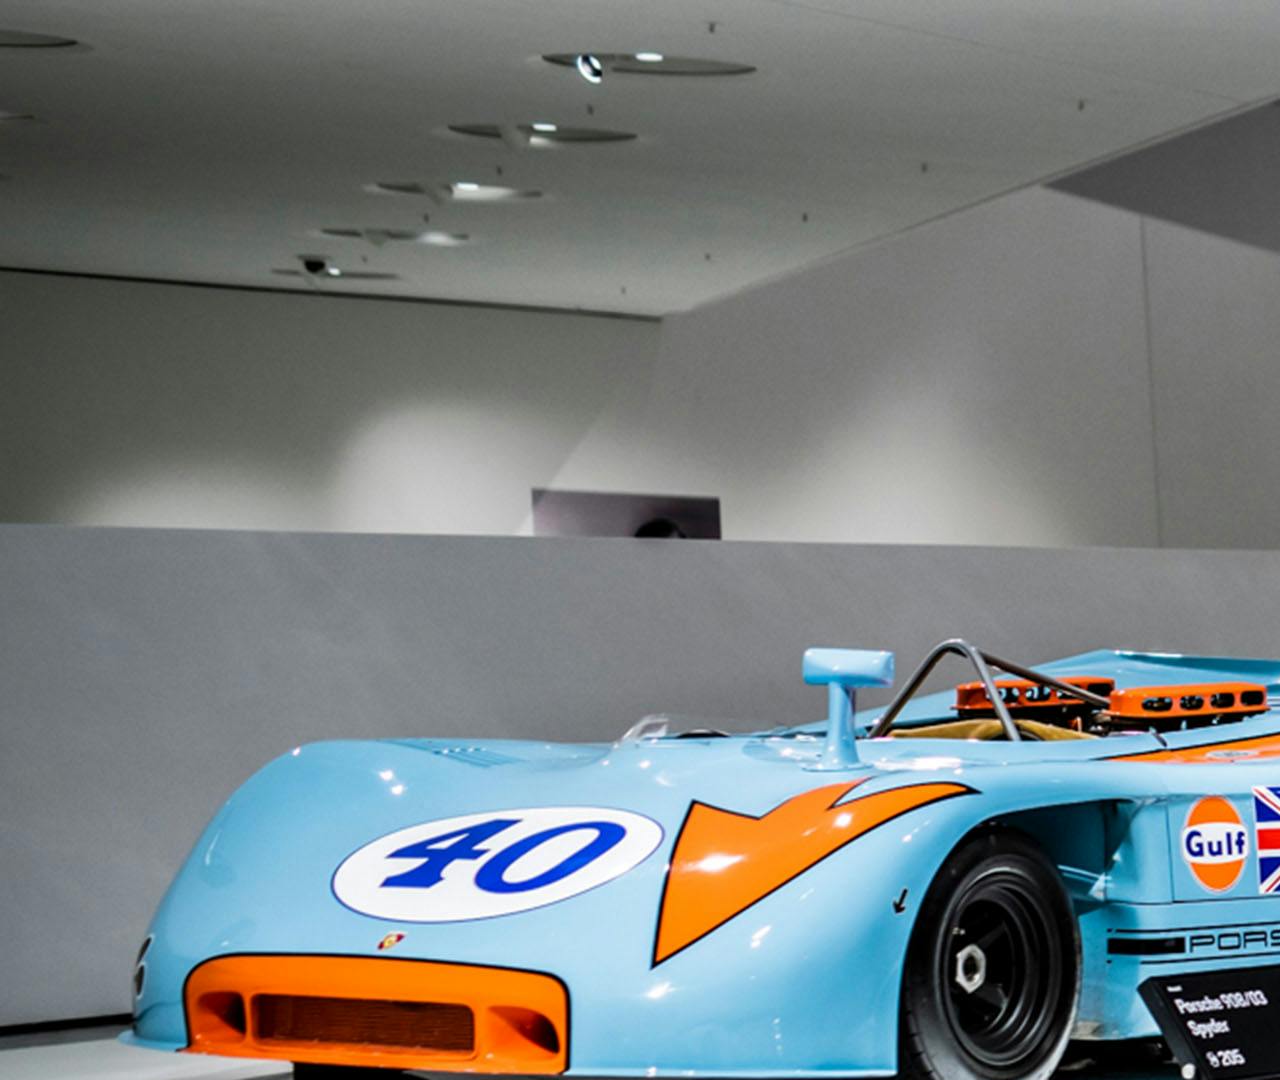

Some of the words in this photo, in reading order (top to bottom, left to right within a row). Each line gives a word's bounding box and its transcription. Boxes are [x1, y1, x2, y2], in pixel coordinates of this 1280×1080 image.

[1185, 830, 1247, 857] Gulf
[379, 818, 627, 894] 40
[1174, 994, 1225, 1014] Porsche
[1186, 1018, 1231, 1039] Spyder
